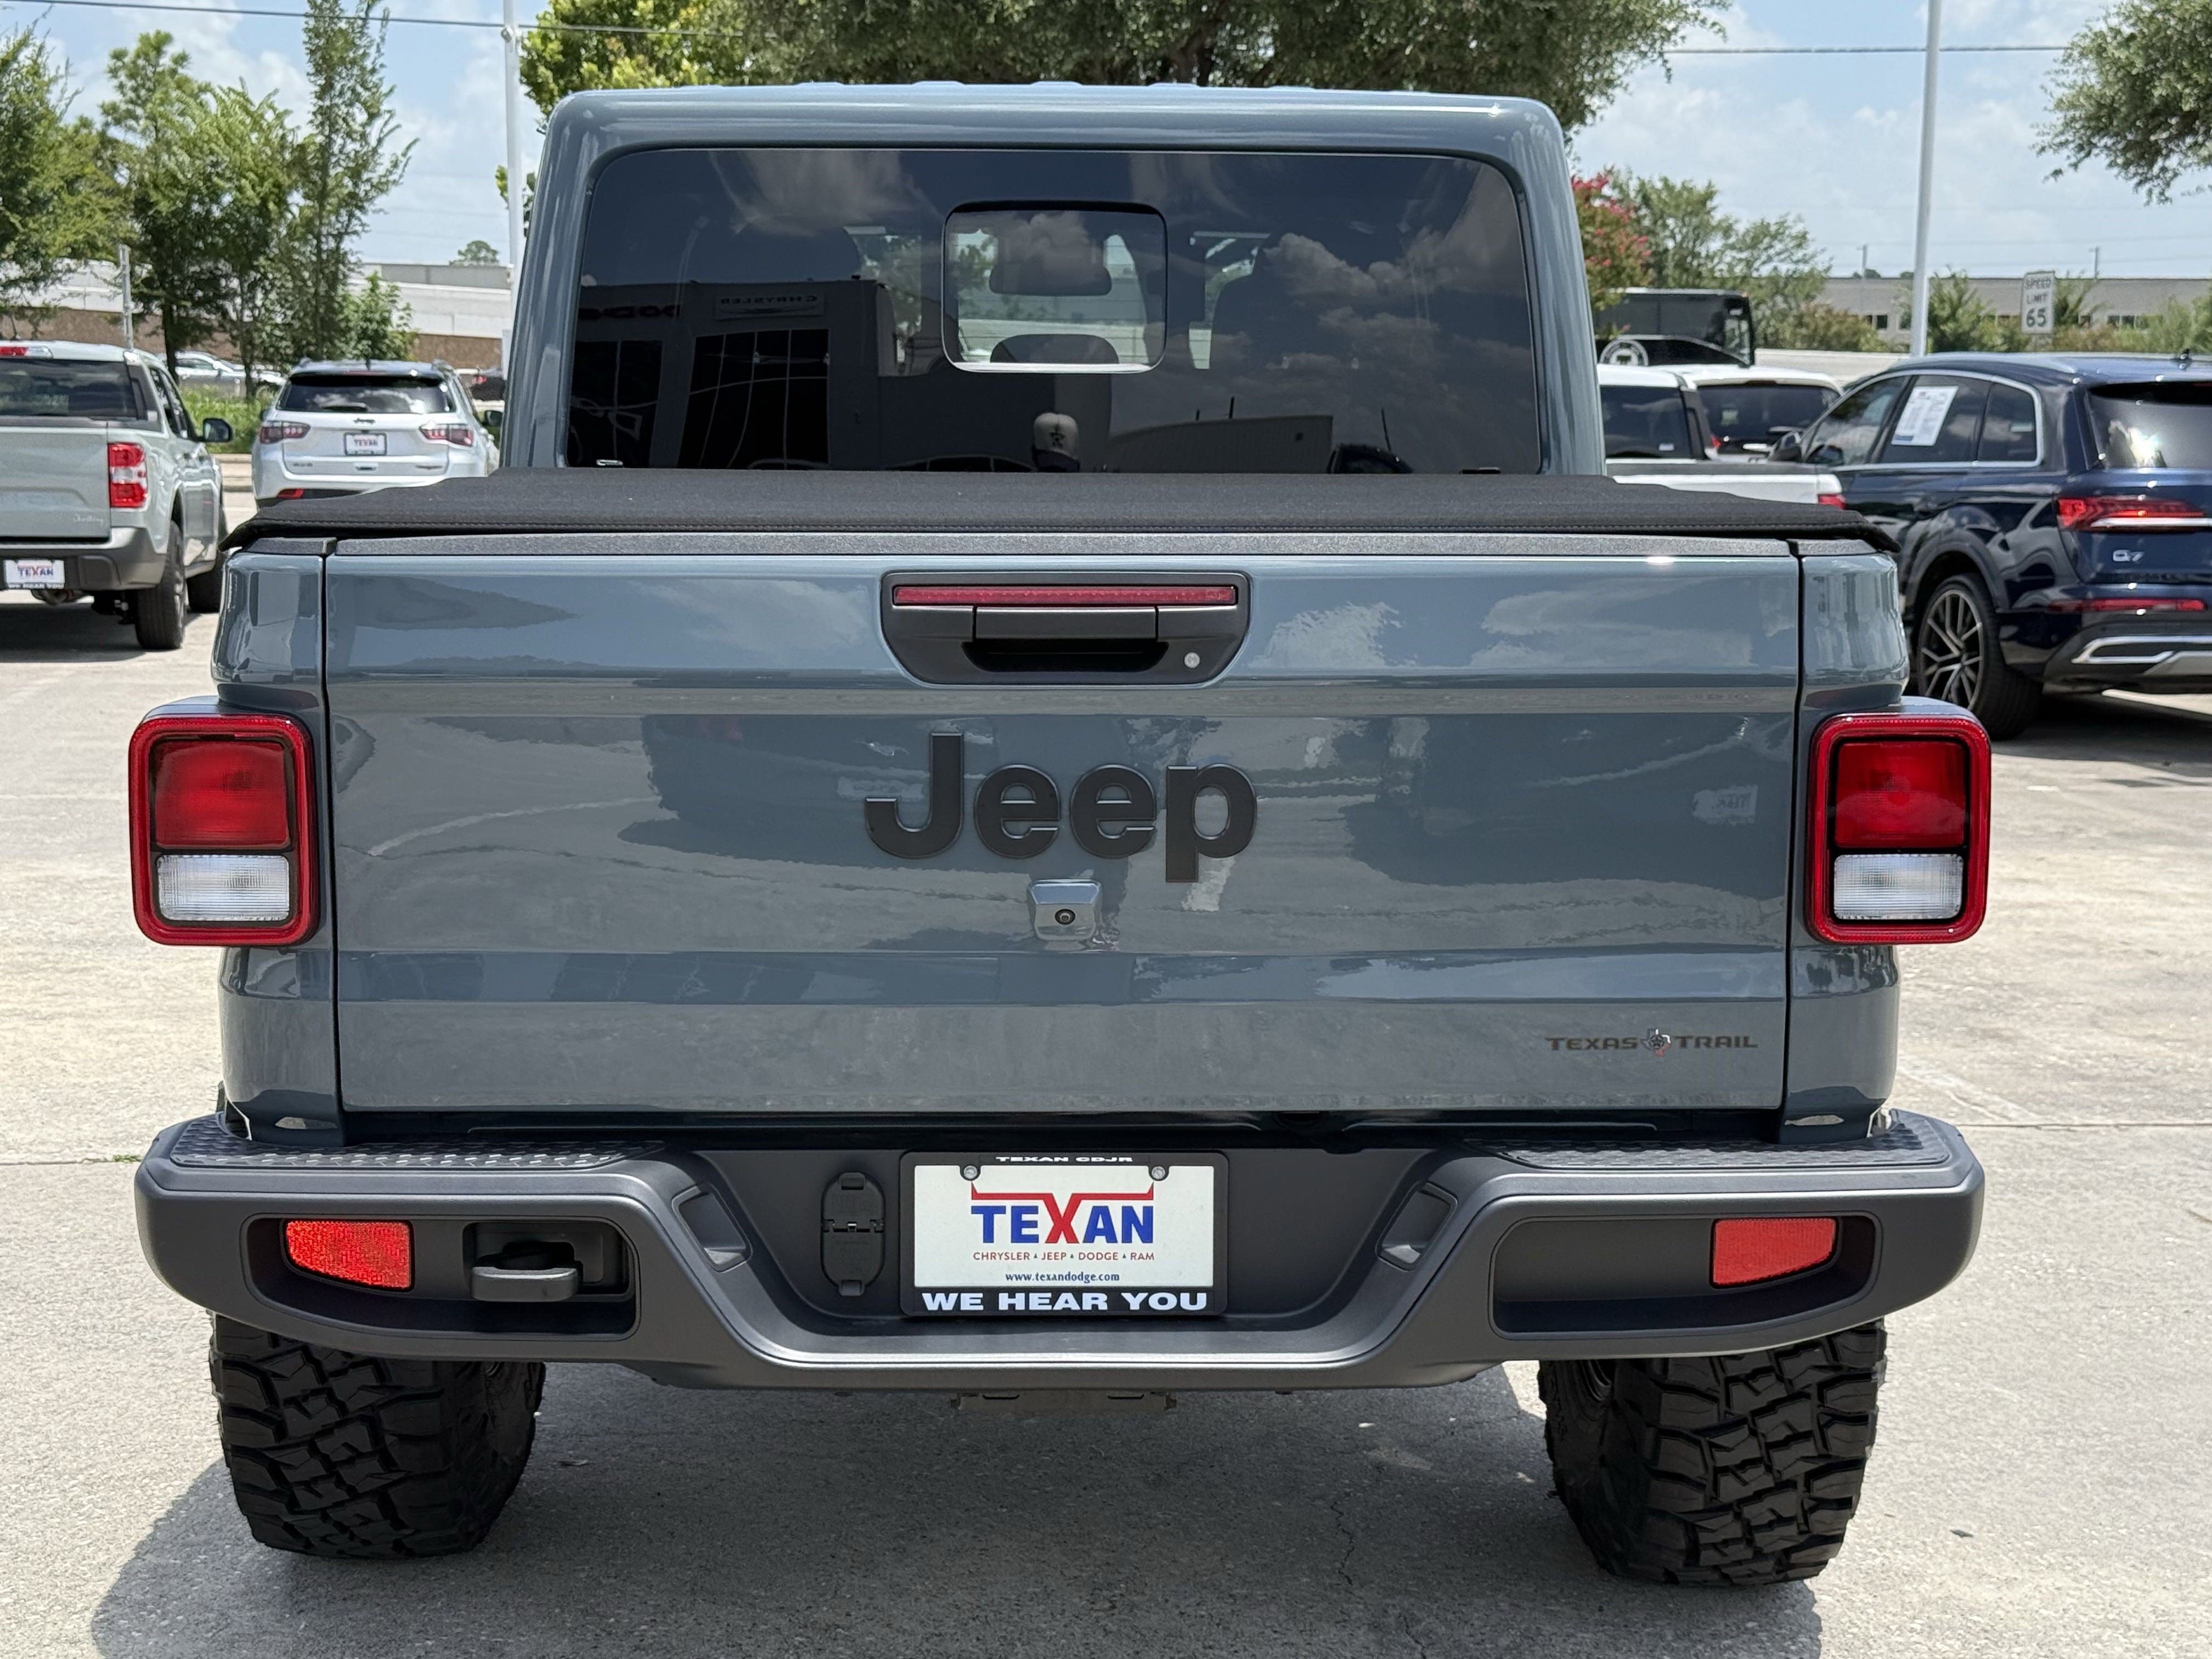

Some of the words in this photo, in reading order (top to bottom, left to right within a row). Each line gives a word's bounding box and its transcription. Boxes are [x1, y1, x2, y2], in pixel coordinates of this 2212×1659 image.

[2025, 278, 2051, 289] SPEED
[2026, 293, 2048, 304] LIMIT
[2026, 307, 2046, 328] 65
[2113, 549, 2144, 562] Q7
[17, 566, 54, 577] TEXAN
[865, 732, 1257, 883] Jeep
[1544, 1037, 1638, 1051] TEXAS
[1674, 1035, 1758, 1049] TRAIL
[971, 1193, 1154, 1244] TEXAN
[973, 1251, 1030, 1261] CHRYSLER
[1041, 1251, 1067, 1261] JEEP
[1078, 1251, 1119, 1261] DODGE
[1130, 1251, 1155, 1261] RAM
[1005, 1271, 1120, 1283] www.texandodge.com
[922, 1293, 984, 1311] WE
[998, 1293, 1108, 1311] HEAR
[1121, 1293, 1207, 1311] YOU
